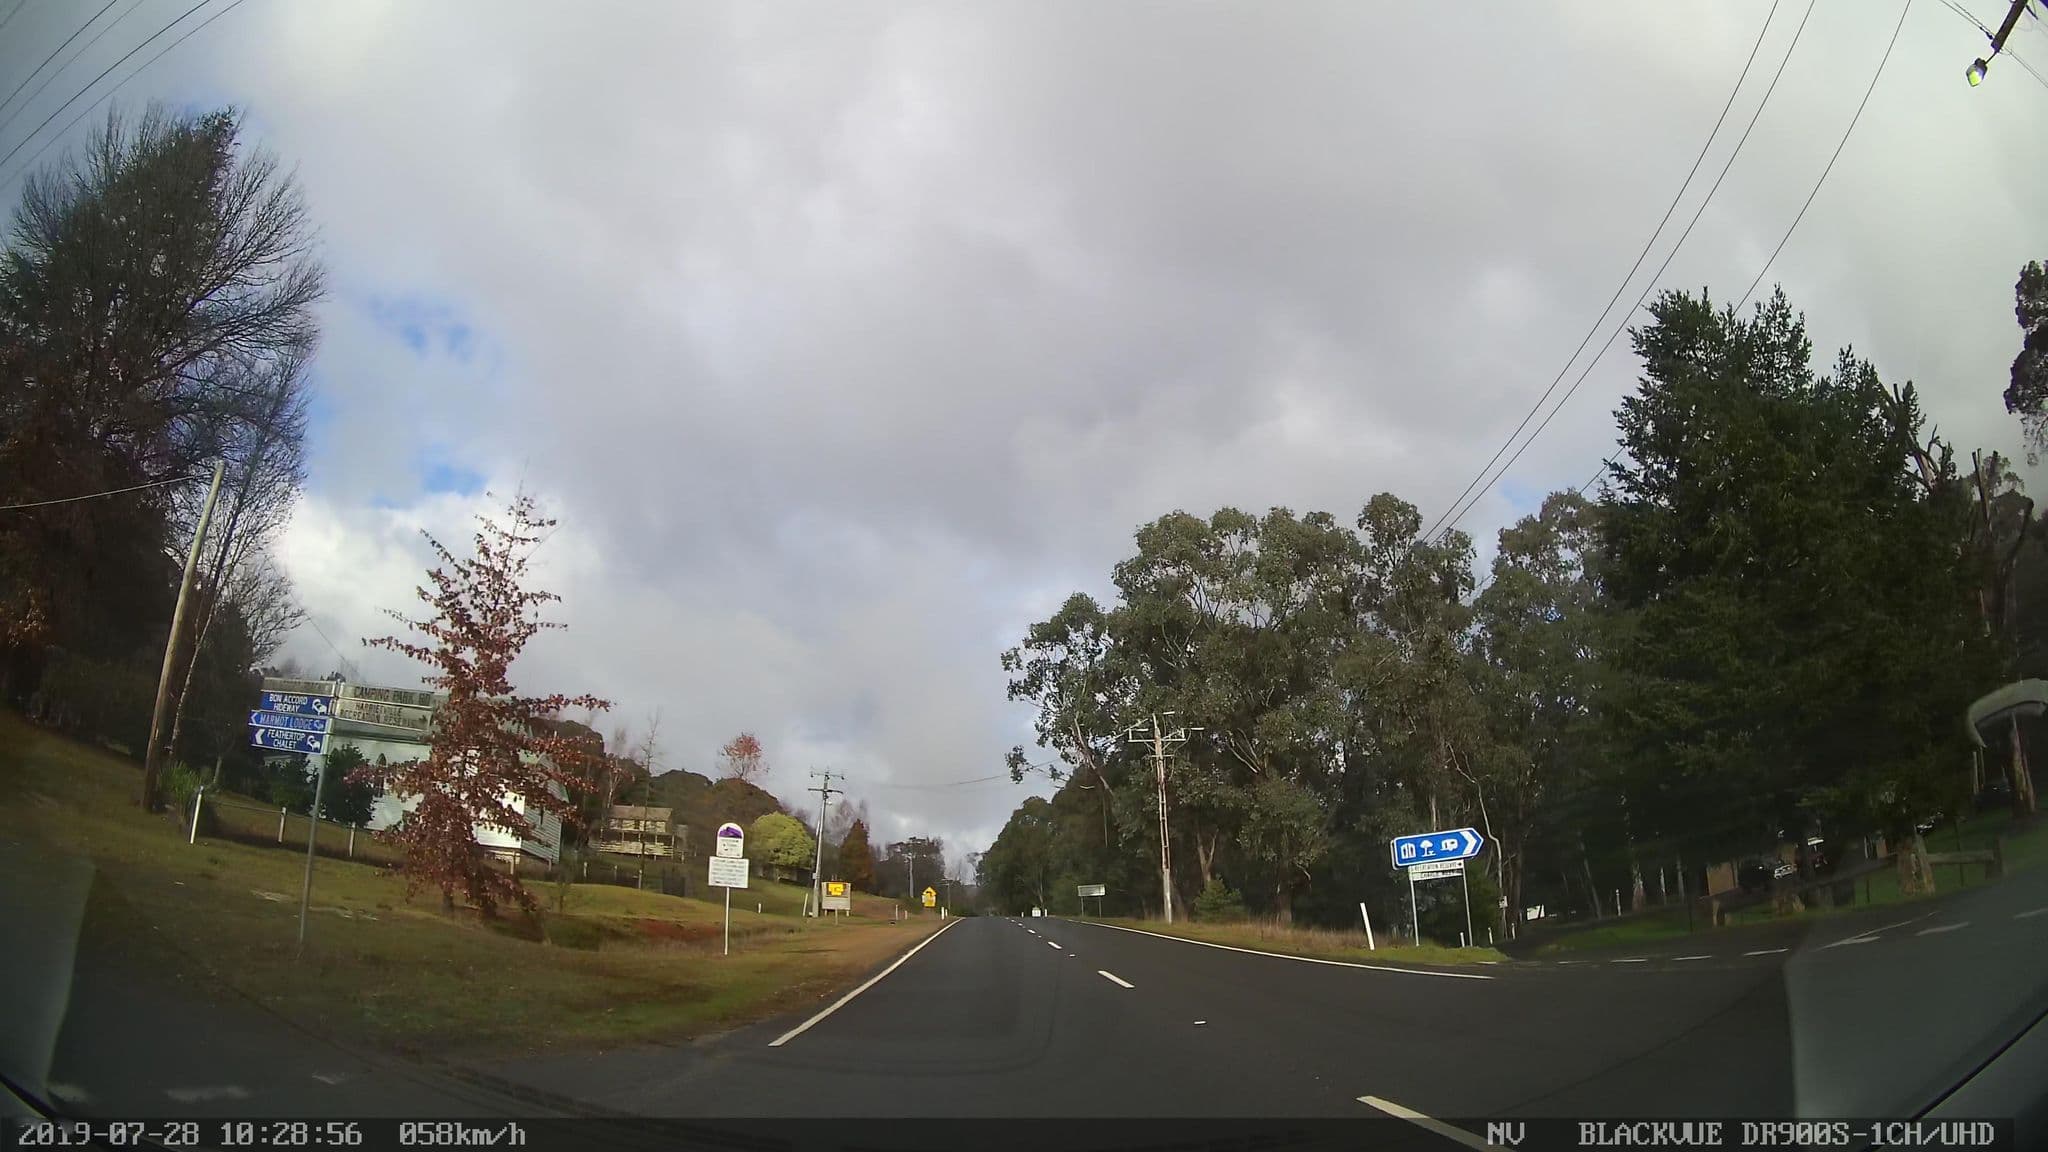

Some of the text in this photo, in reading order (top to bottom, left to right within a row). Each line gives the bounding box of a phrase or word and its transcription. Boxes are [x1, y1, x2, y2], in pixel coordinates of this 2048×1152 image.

[269, 693, 308, 705] BON ACCORD
[354, 686, 431, 706] CAMPING PARK RD
[259, 713, 313, 730] MARMOT LODGE
[267, 729, 306, 741] FEATHERTOP
[273, 738, 297, 749] CHALET
